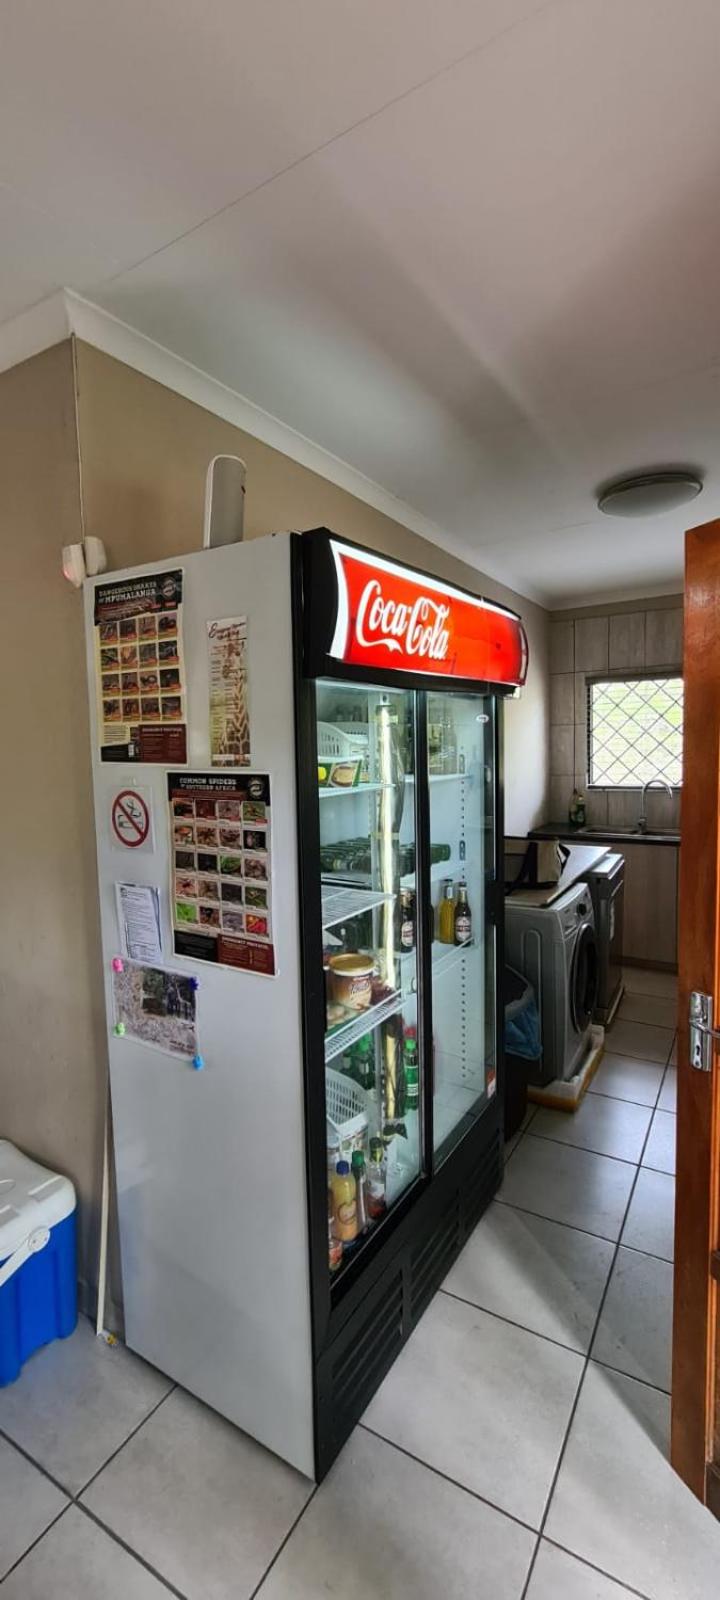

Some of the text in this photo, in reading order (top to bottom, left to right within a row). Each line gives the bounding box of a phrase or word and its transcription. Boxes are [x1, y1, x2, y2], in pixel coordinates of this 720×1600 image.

[105, 588, 156, 603] MPUMALANGA
[355, 579, 449, 660] Coca-Cola
[179, 777, 206, 785] COMMON
